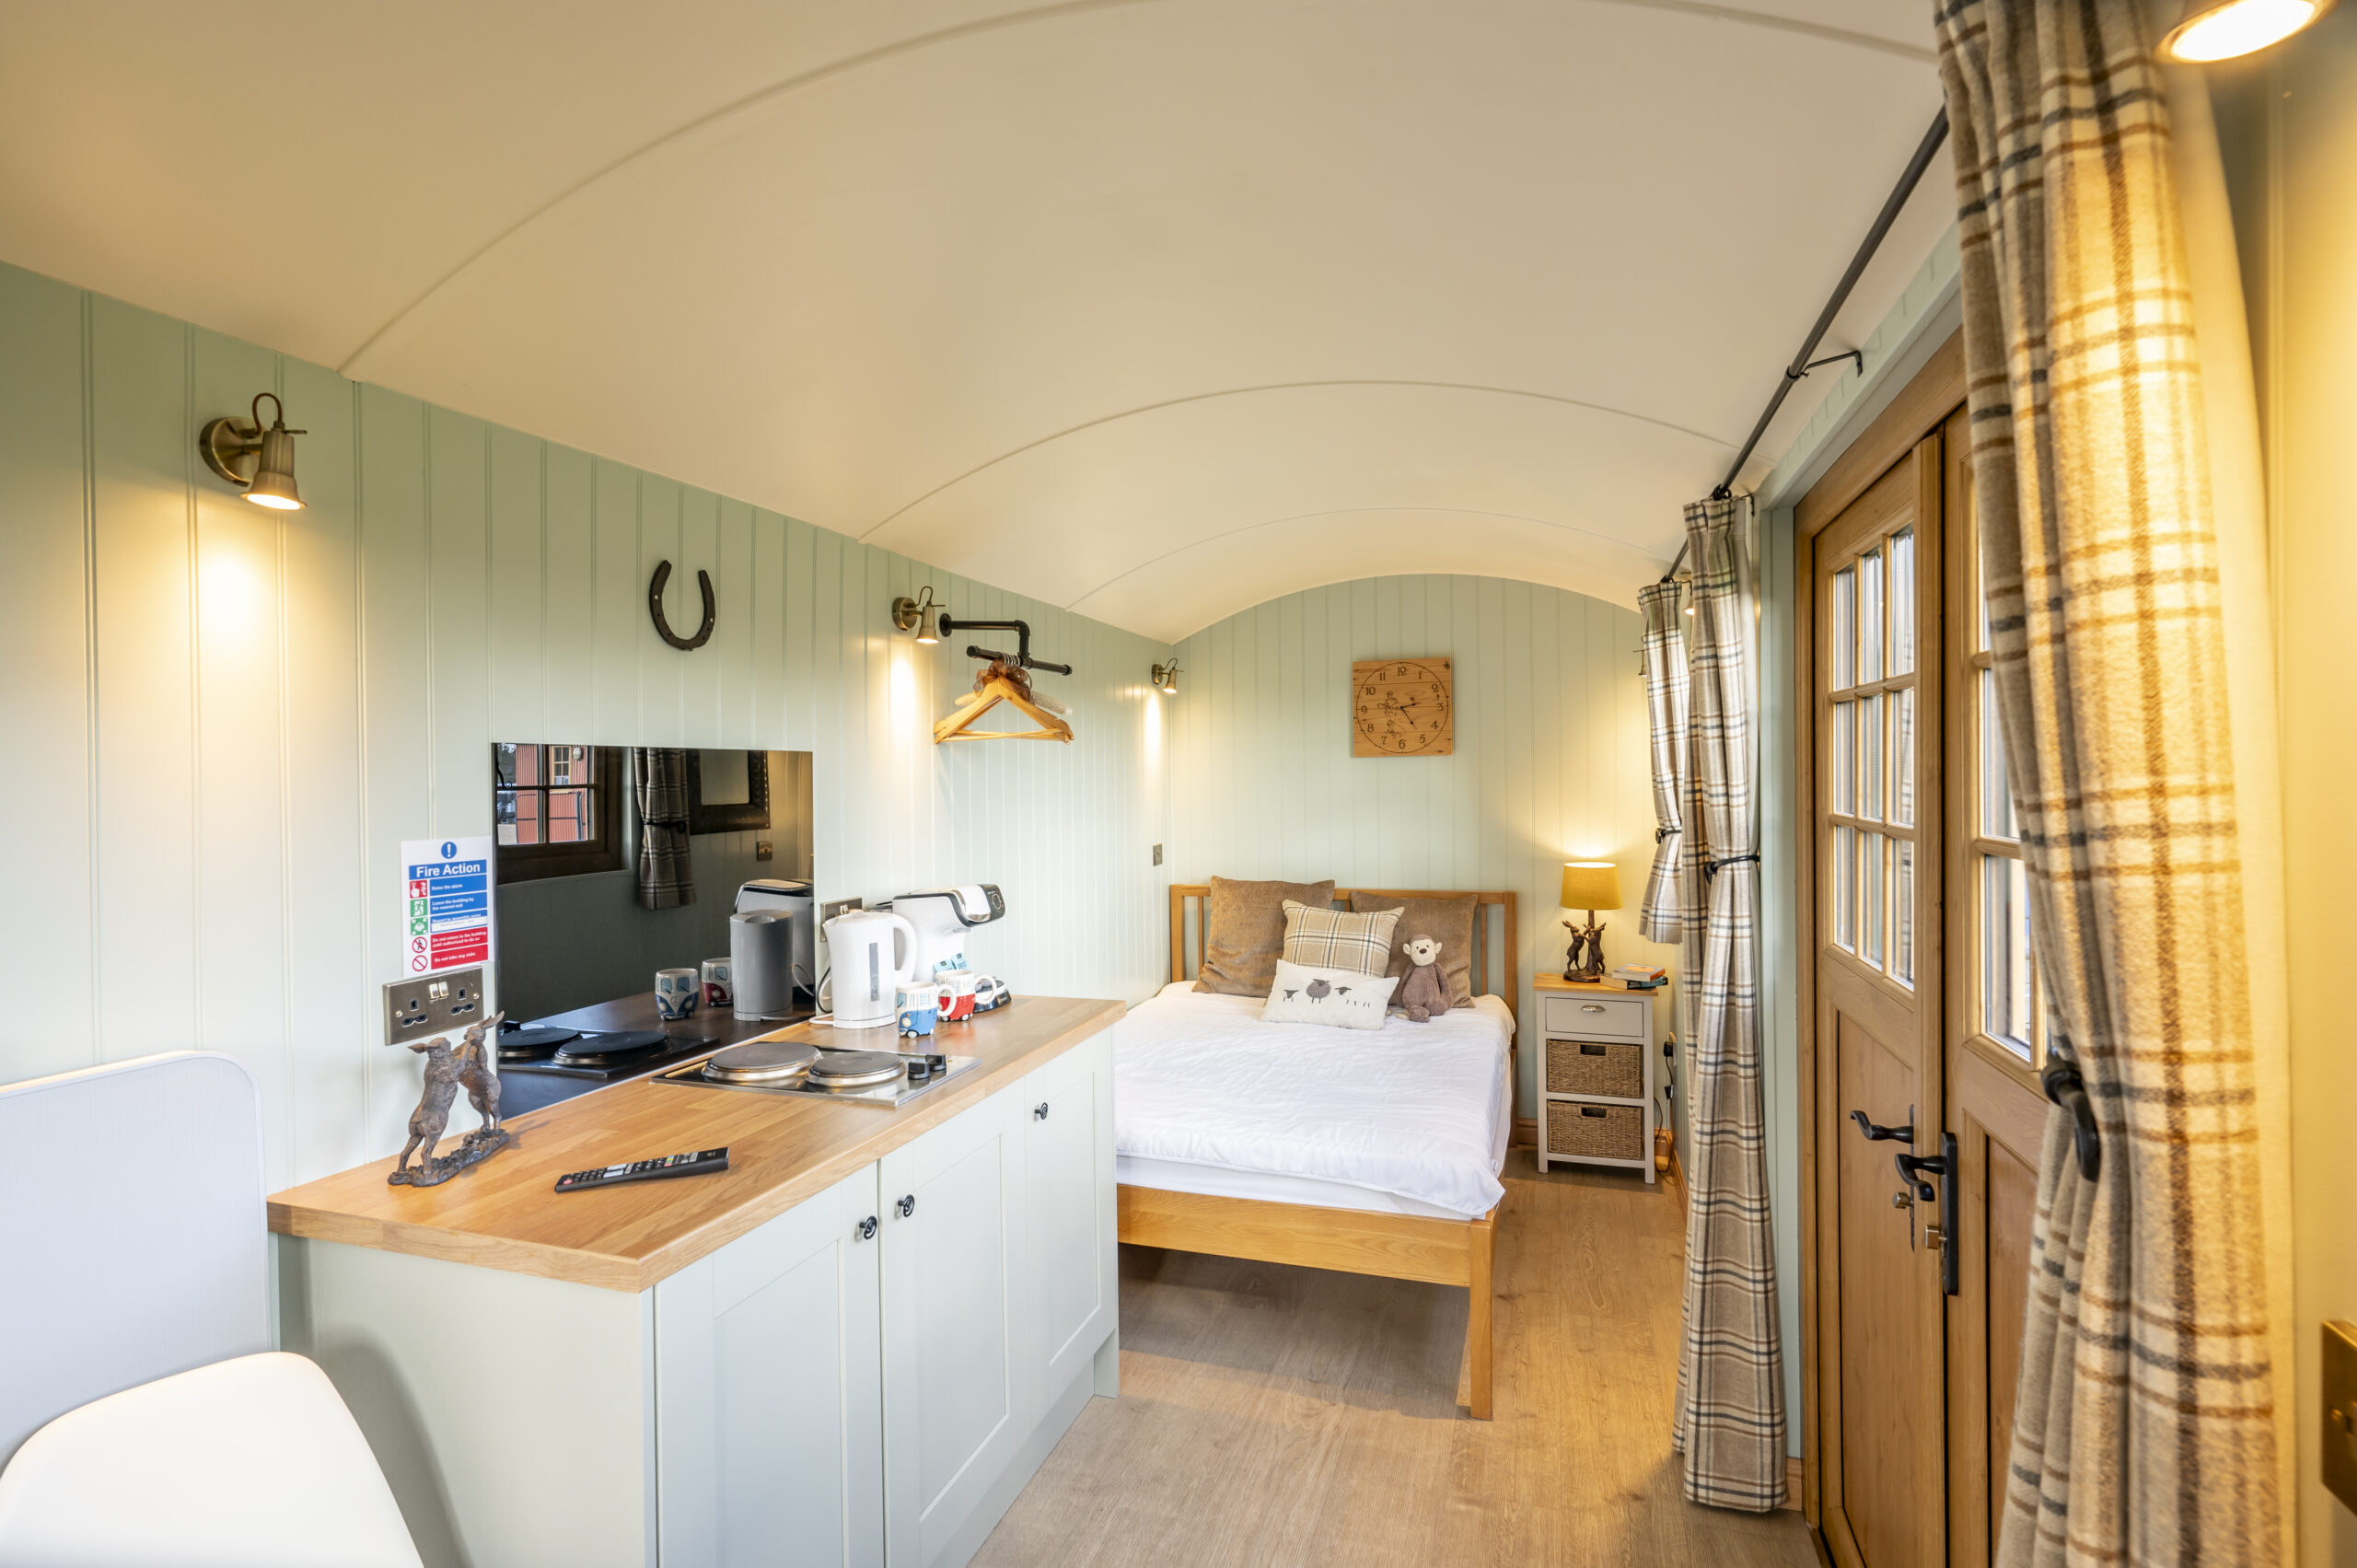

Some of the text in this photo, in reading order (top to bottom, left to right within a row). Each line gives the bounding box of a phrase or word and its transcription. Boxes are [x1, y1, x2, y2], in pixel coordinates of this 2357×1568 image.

[1398, 666, 1407, 676] 12
[1418, 671, 1422, 679] 1
[1379, 672, 1385, 681] 11
[1366, 686, 1376, 695] 10
[1431, 684, 1439, 693] 2
[1361, 706, 1367, 714] 9
[1437, 702, 1444, 711] 3
[1367, 723, 1374, 732] 8
[1430, 720, 1439, 729] 4
[1381, 736, 1387, 745] 7
[1419, 734, 1426, 743] 5
[1399, 739, 1406, 749] 6
[416, 863, 480, 877] Fire Action
